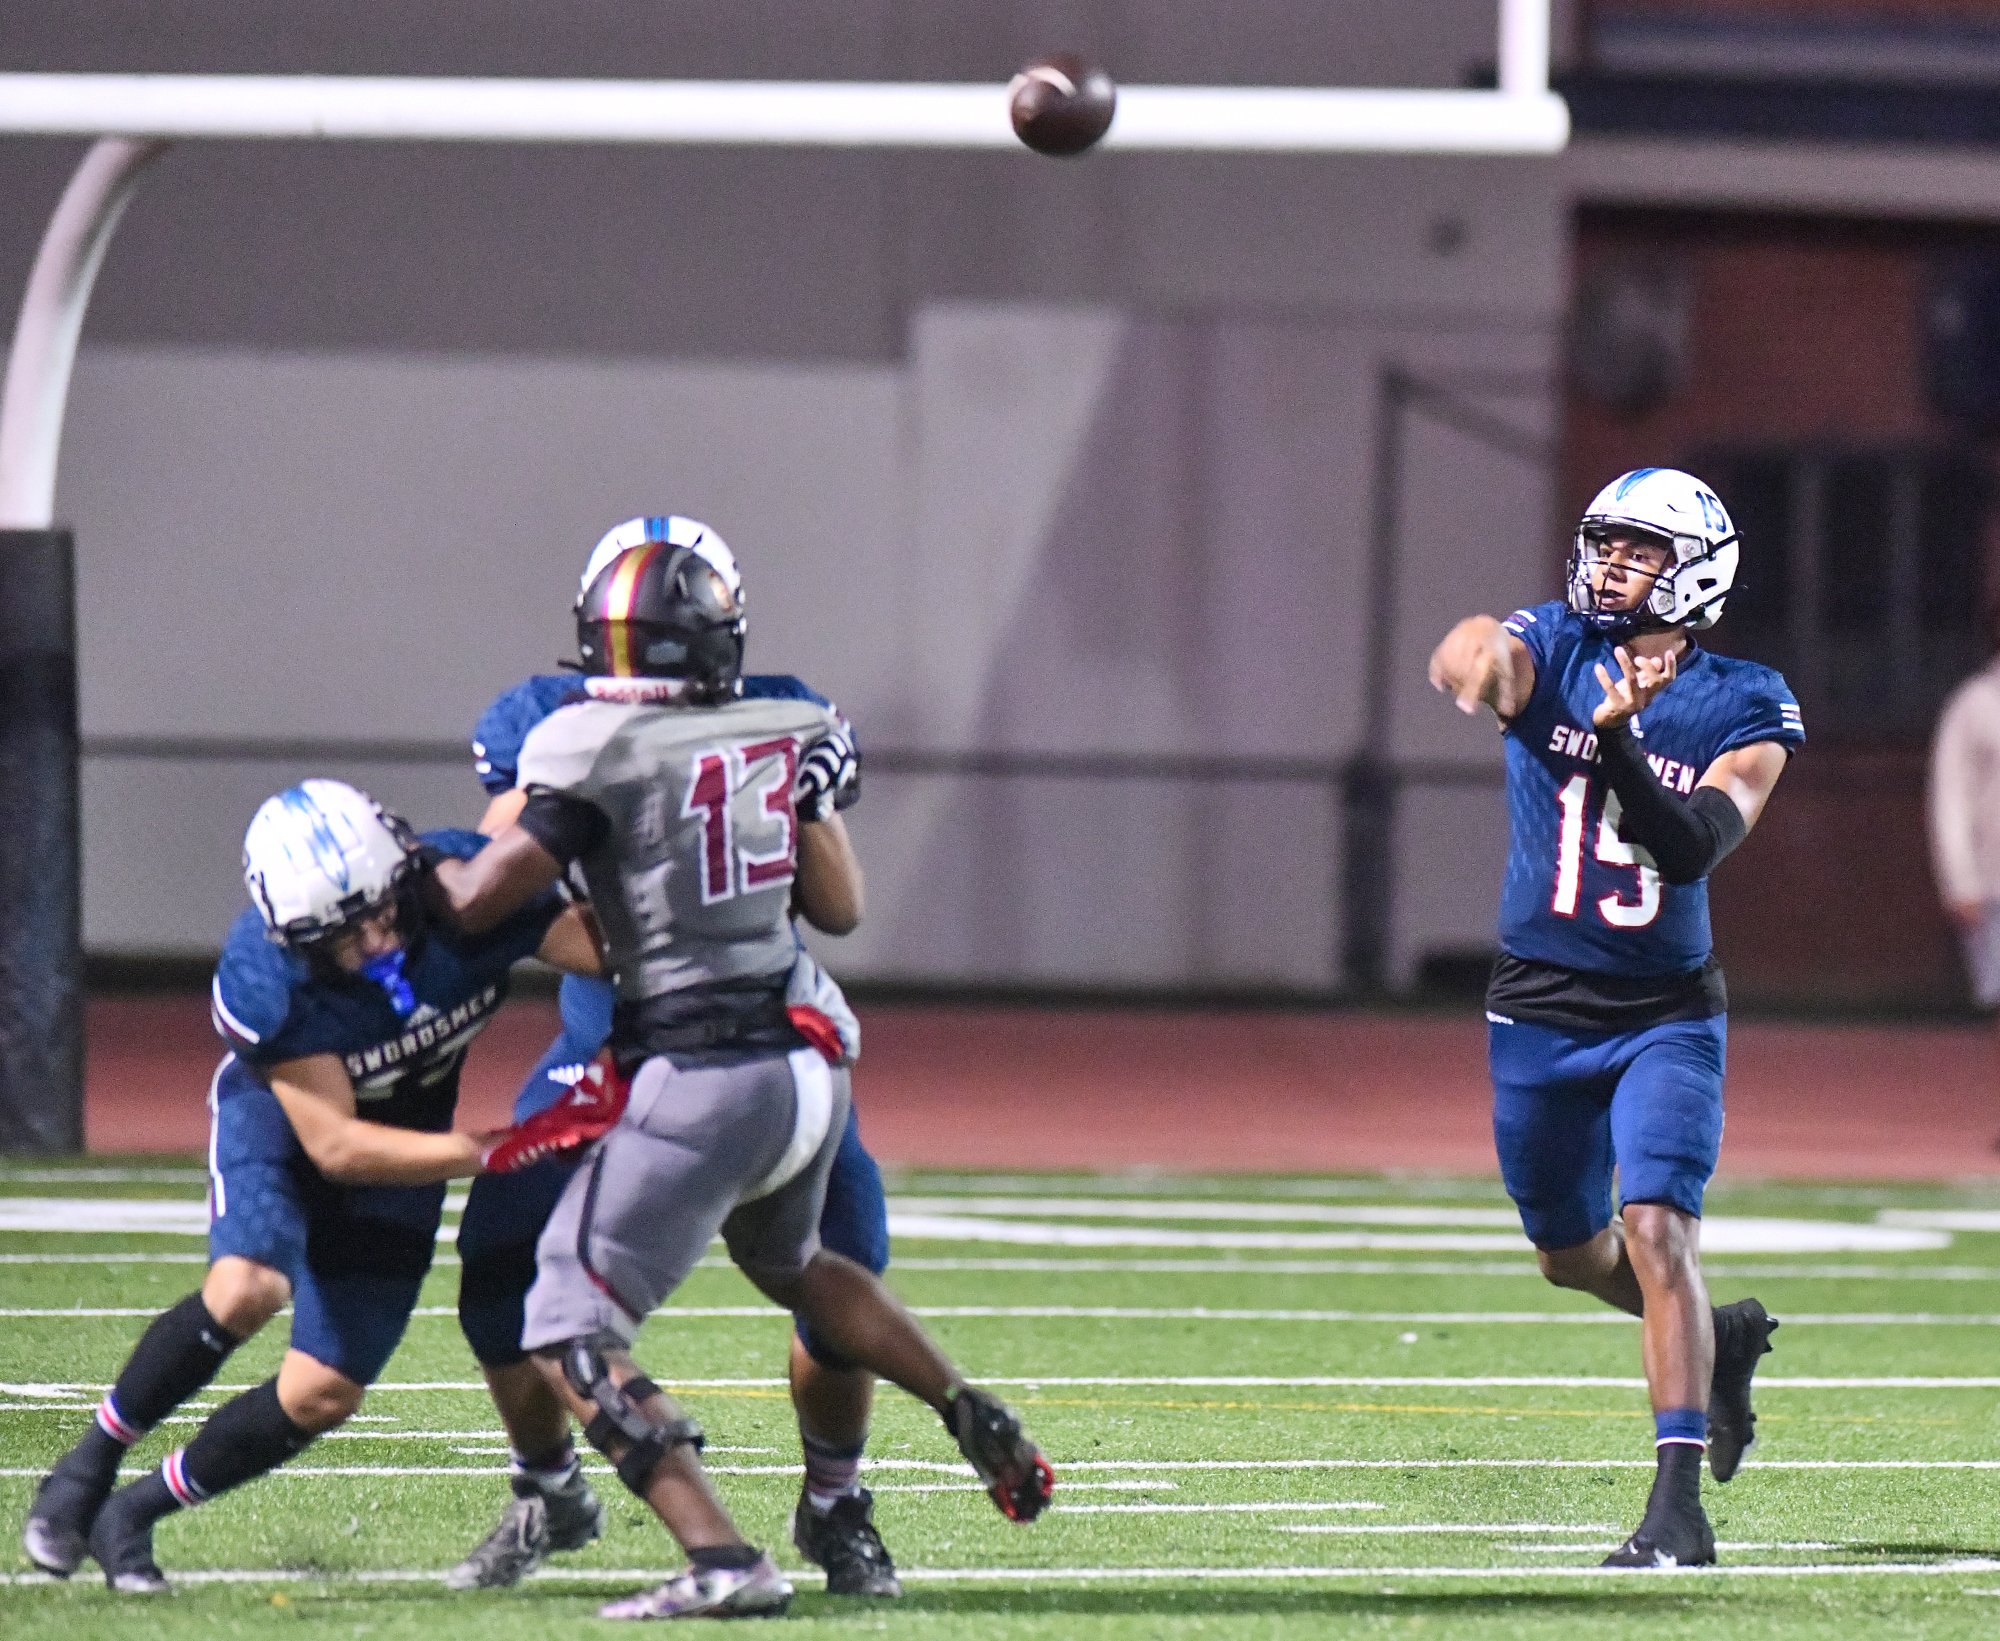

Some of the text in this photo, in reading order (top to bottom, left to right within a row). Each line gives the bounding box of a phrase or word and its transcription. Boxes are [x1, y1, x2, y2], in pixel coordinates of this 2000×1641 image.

[1695, 490, 1727, 533] 15
[1549, 725, 1696, 795] SWOMEN
[680, 735, 800, 906] 13
[1552, 773, 1663, 928] 15
